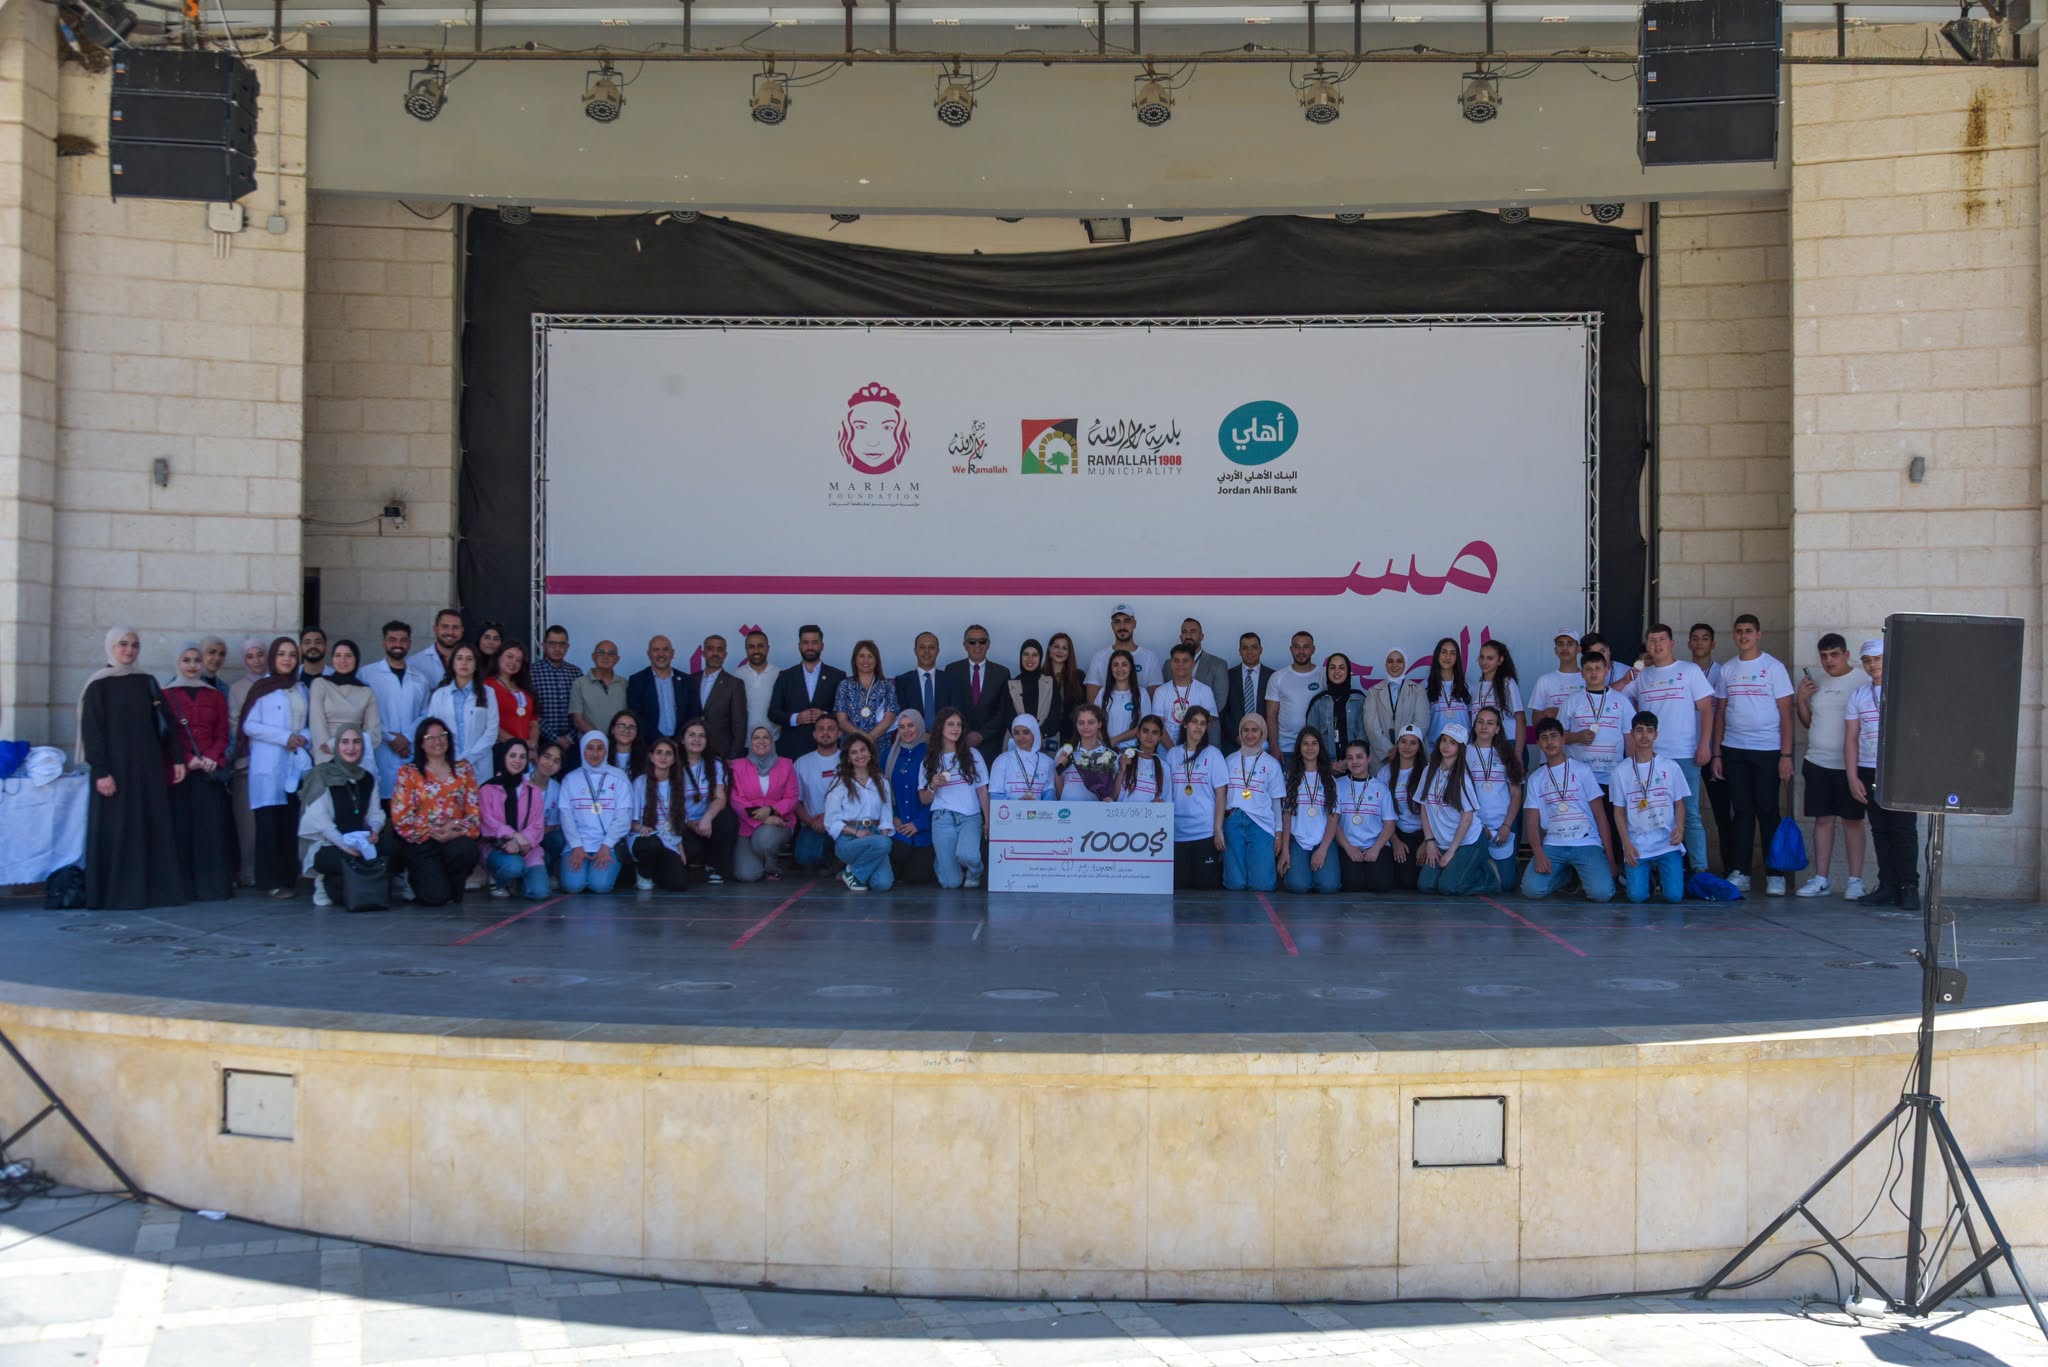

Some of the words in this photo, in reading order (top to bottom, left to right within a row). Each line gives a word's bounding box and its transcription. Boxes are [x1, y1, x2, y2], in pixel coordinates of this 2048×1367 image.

[1145, 418, 1181, 454] بلدية
[1232, 412, 1284, 451] أهلي
[1087, 454, 1157, 466] RAMALLAH
[1158, 455, 1182, 466] 1908
[1087, 466, 1182, 476] MUNICIPALITY
[1216, 469, 1243, 484] الأردني
[1244, 469, 1272, 484] الأهلي
[1273, 471, 1298, 481] البنك
[829, 482, 919, 491] MARIAM
[1217, 486, 1251, 495] Jordan
[1252, 485, 1272, 495] Ahli
[1273, 485, 1298, 495] Bank
[1676, 672, 1683, 681] 2
[1612, 702, 1619, 710] 3
[1079, 827, 1169, 857] 1000$
